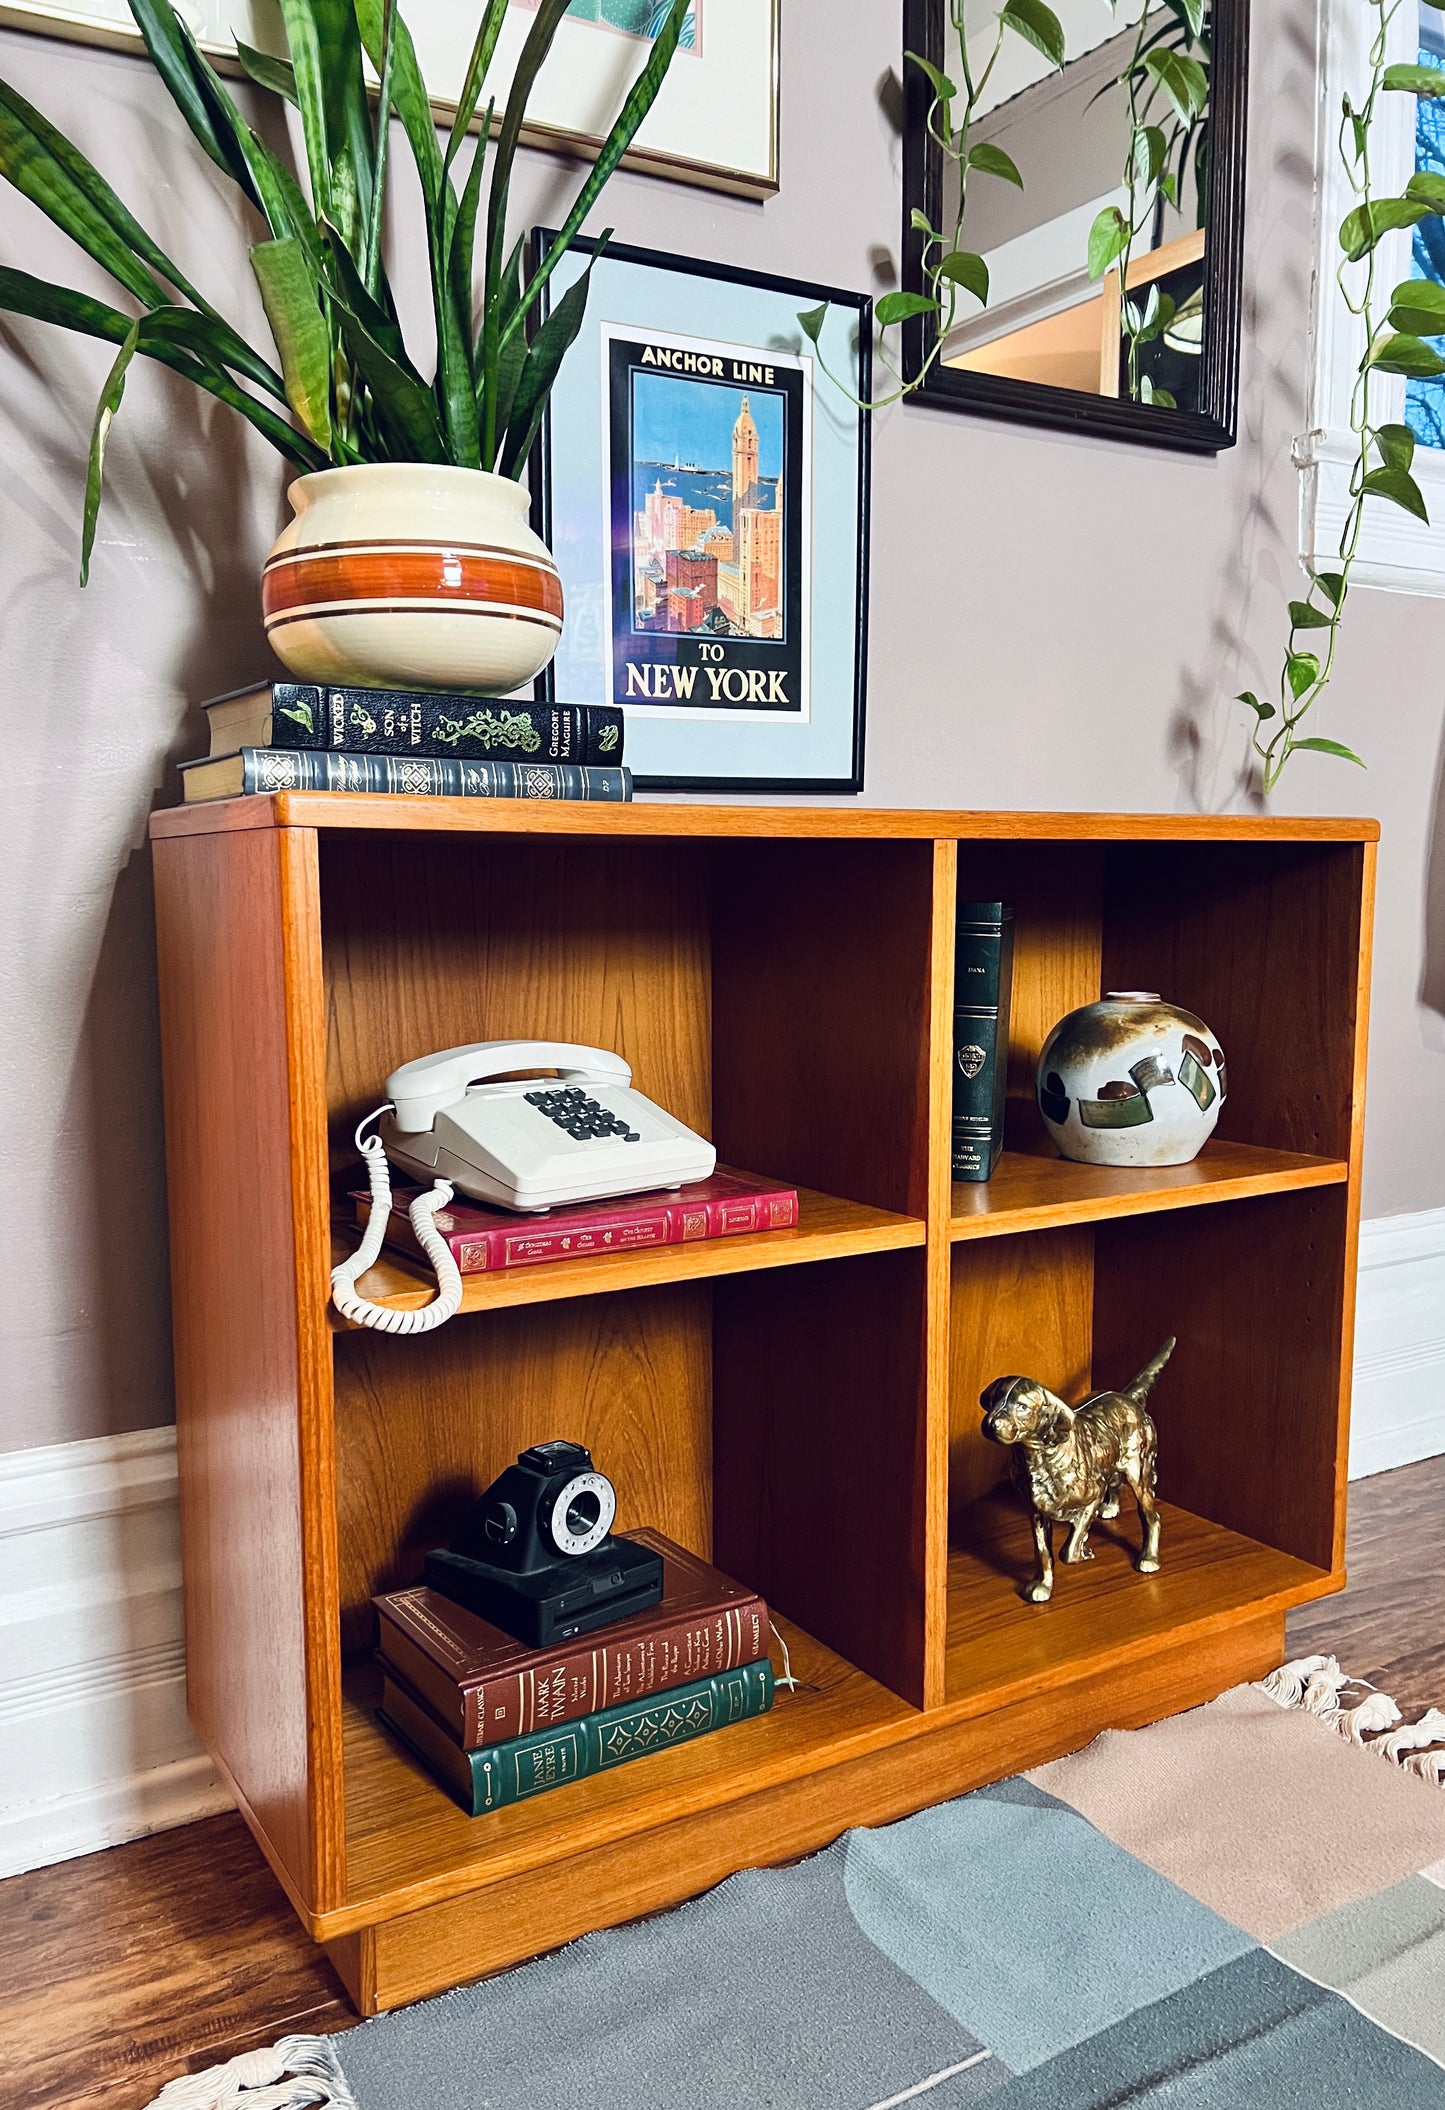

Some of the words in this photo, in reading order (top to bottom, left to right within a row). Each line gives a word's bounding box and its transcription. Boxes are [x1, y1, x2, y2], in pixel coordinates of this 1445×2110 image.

[641, 346, 724, 377] ANCHOR
[732, 362, 775, 385] LINE
[699, 643, 725, 662] TO
[625, 662, 697, 699] NEW
[703, 667, 789, 703] YORK
[333, 694, 345, 745] WICKED
[384, 709, 394, 736] SON
[397, 723, 408, 732] of
[411, 703, 421, 745] WITCH
[549, 709, 559, 757] GREGORY
[561, 710, 571, 757] MAGUIRE
[752, 1613, 760, 1655] GRAMERCY
[539, 1678, 550, 1718] MARK
[552, 1666, 566, 1720] TWAIN
[534, 1750, 545, 1786] JANE
[546, 1745, 556, 1780] EYRE
